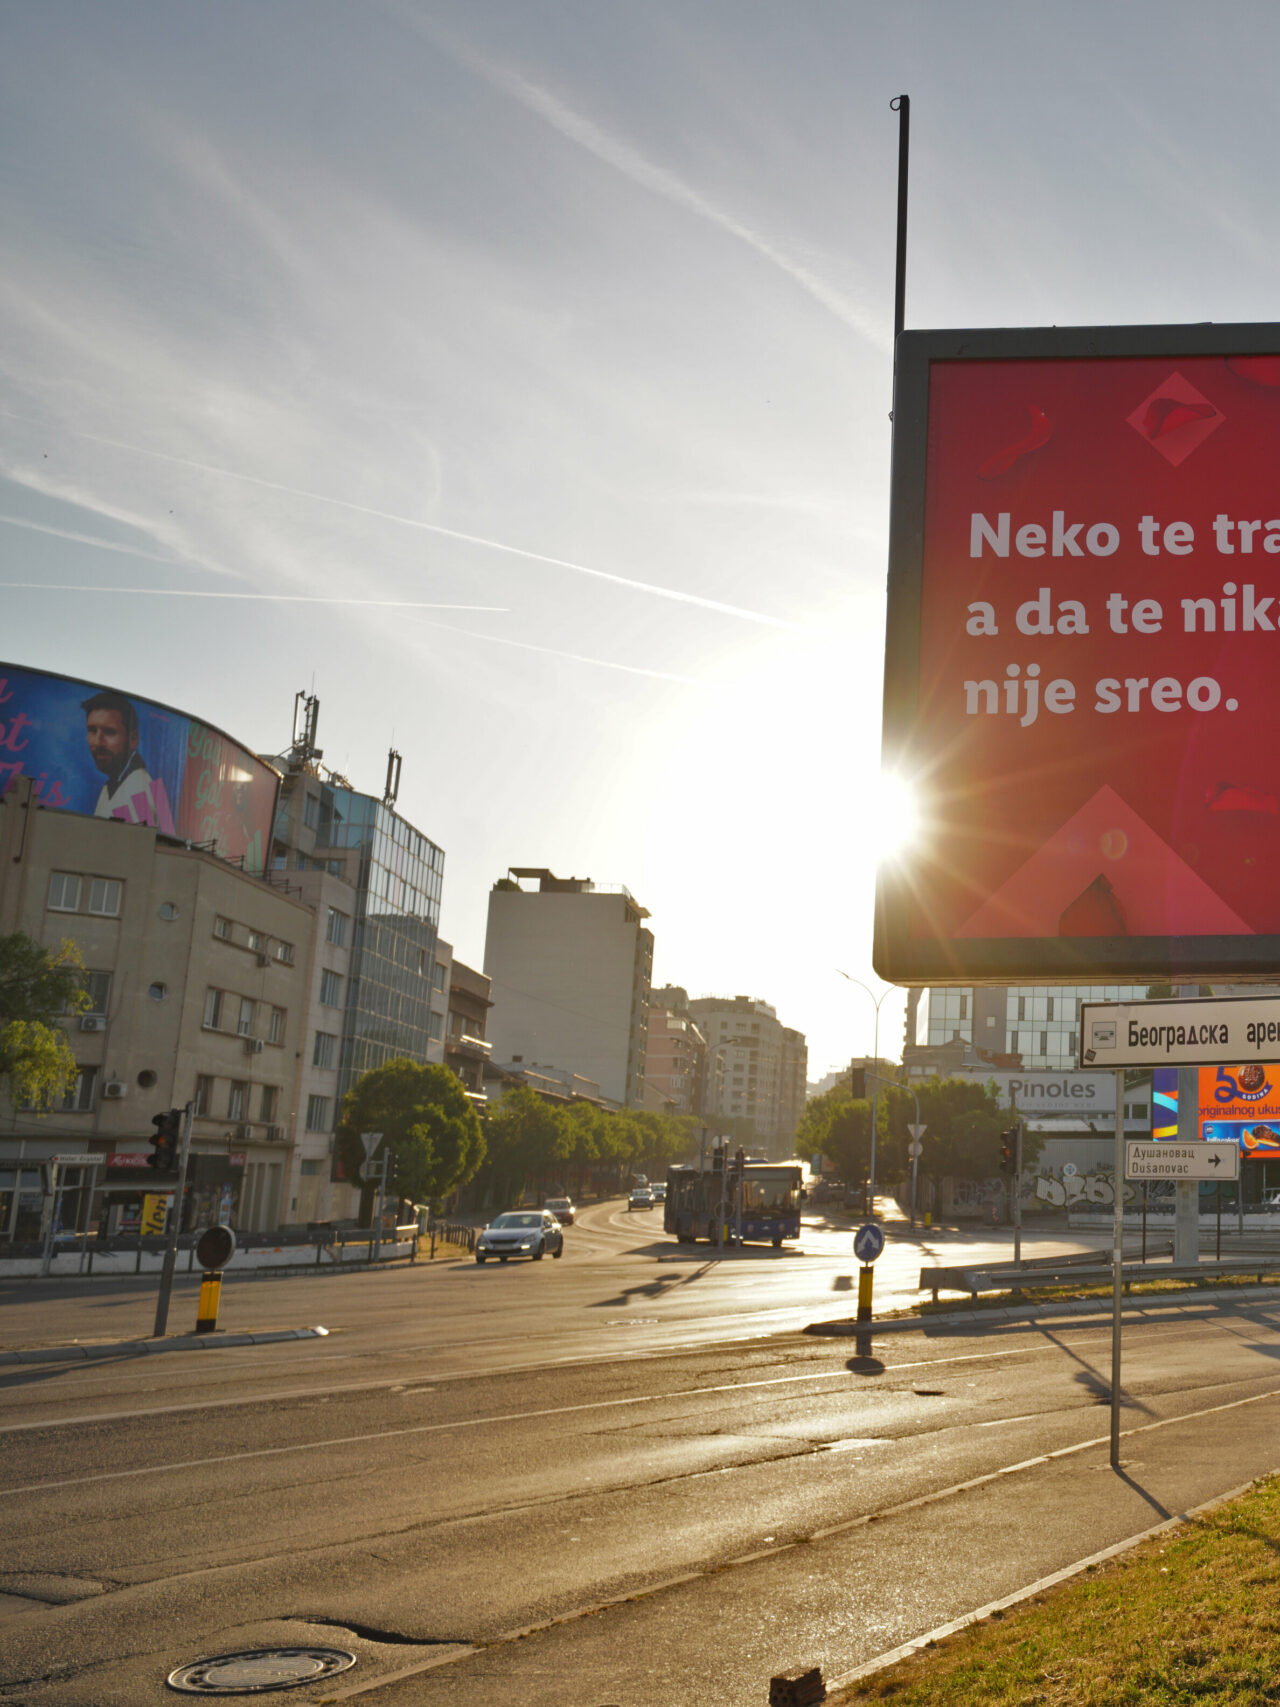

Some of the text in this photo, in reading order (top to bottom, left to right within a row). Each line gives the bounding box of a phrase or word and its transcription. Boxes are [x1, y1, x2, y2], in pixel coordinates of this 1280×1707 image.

[969, 510, 1120, 558] Neko
[1138, 515, 1195, 556] te
[965, 601, 999, 636] a
[1015, 587, 1090, 636] da
[1106, 593, 1163, 634] te
[963, 663, 1239, 728] nije sreo.
[1128, 1020, 1229, 1053] Београдска
[1008, 1079, 1096, 1098] Pinoles
[1132, 1147, 1196, 1160] Душановац
[1132, 1161, 1189, 1174] Dušanovac
